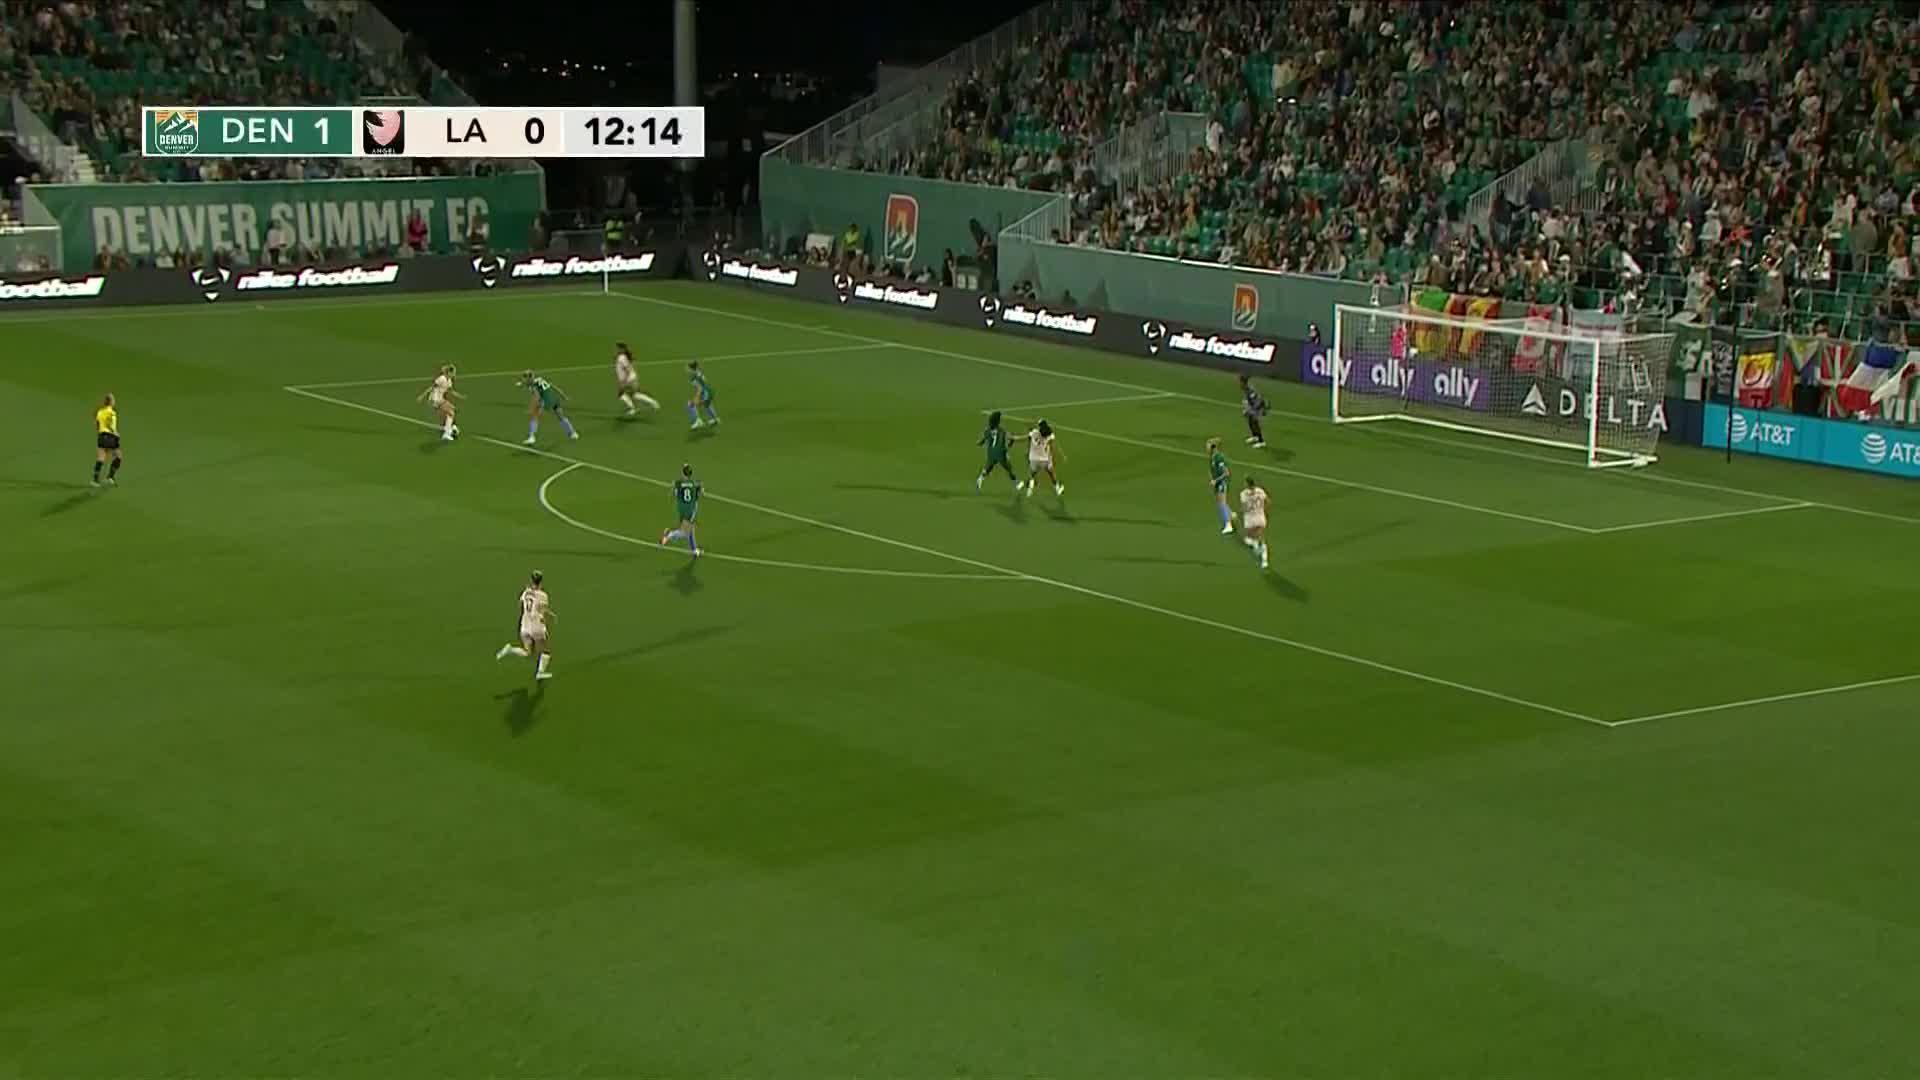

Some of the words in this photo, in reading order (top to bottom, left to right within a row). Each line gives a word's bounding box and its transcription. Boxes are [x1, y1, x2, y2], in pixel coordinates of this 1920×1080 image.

[93, 204, 260, 254] DENVER
[237, 270, 297, 290] nike
[297, 264, 399, 287] football
[511, 259, 563, 277] nike
[564, 253, 655, 275] football
[750, 262, 798, 286] football
[0, 277, 105, 299] ootball
[854, 282, 885, 300] nike
[884, 285, 938, 309] football
[1003, 305, 1036, 325] nike
[1035, 308, 1097, 334] football
[1169, 331, 1206, 352] nike
[1205, 335, 1276, 362] football
[1311, 348, 1352, 386] aly
[1370, 358, 1415, 395] ally
[1434, 366, 1480, 407] ally
[1750, 421, 1795, 446] AT&T
[683, 488, 692, 502] 8
